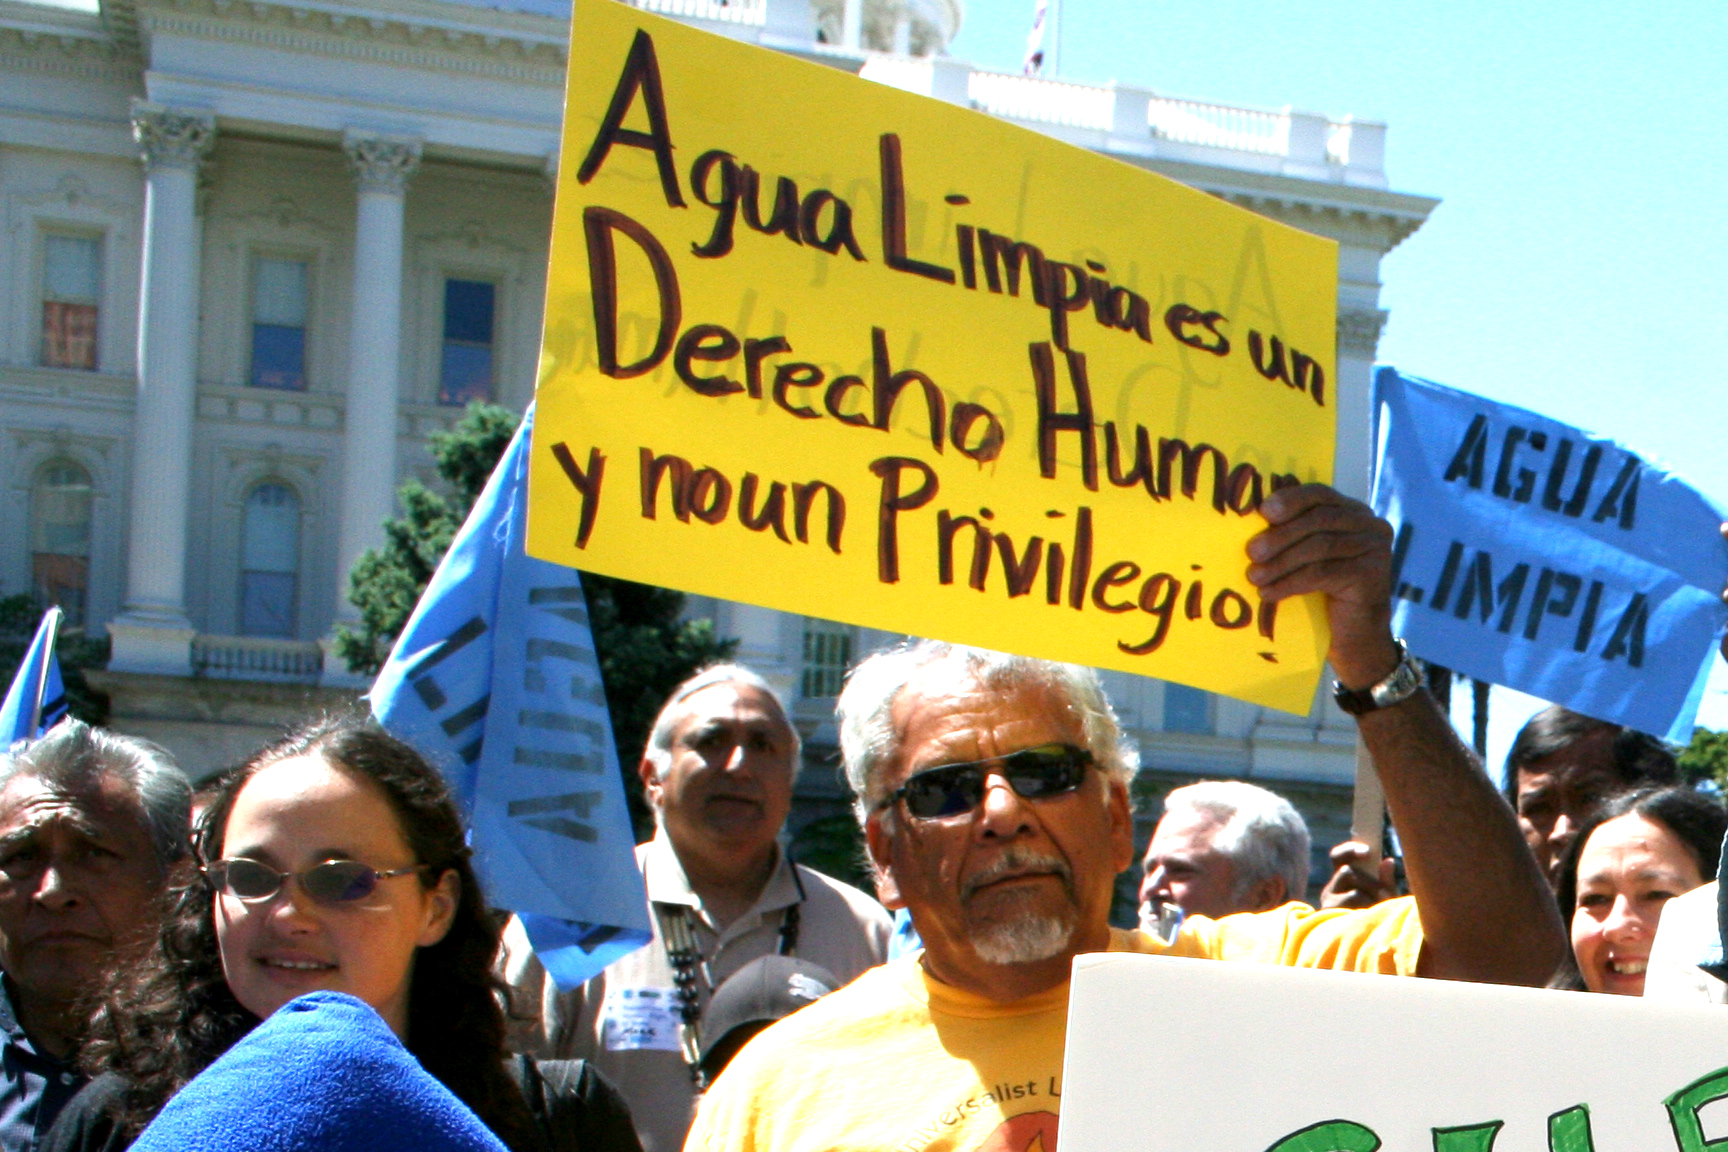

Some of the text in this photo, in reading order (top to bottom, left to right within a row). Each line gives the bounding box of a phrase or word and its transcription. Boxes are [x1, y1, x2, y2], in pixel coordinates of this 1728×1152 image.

[577, 28, 1325, 407] Agua Limpia es un
[583, 207, 1302, 517] Derecho Huma
[551, 441, 607, 550] y
[1443, 413, 1641, 531] AGUA
[1391, 523, 1648, 669] LIMPIA
